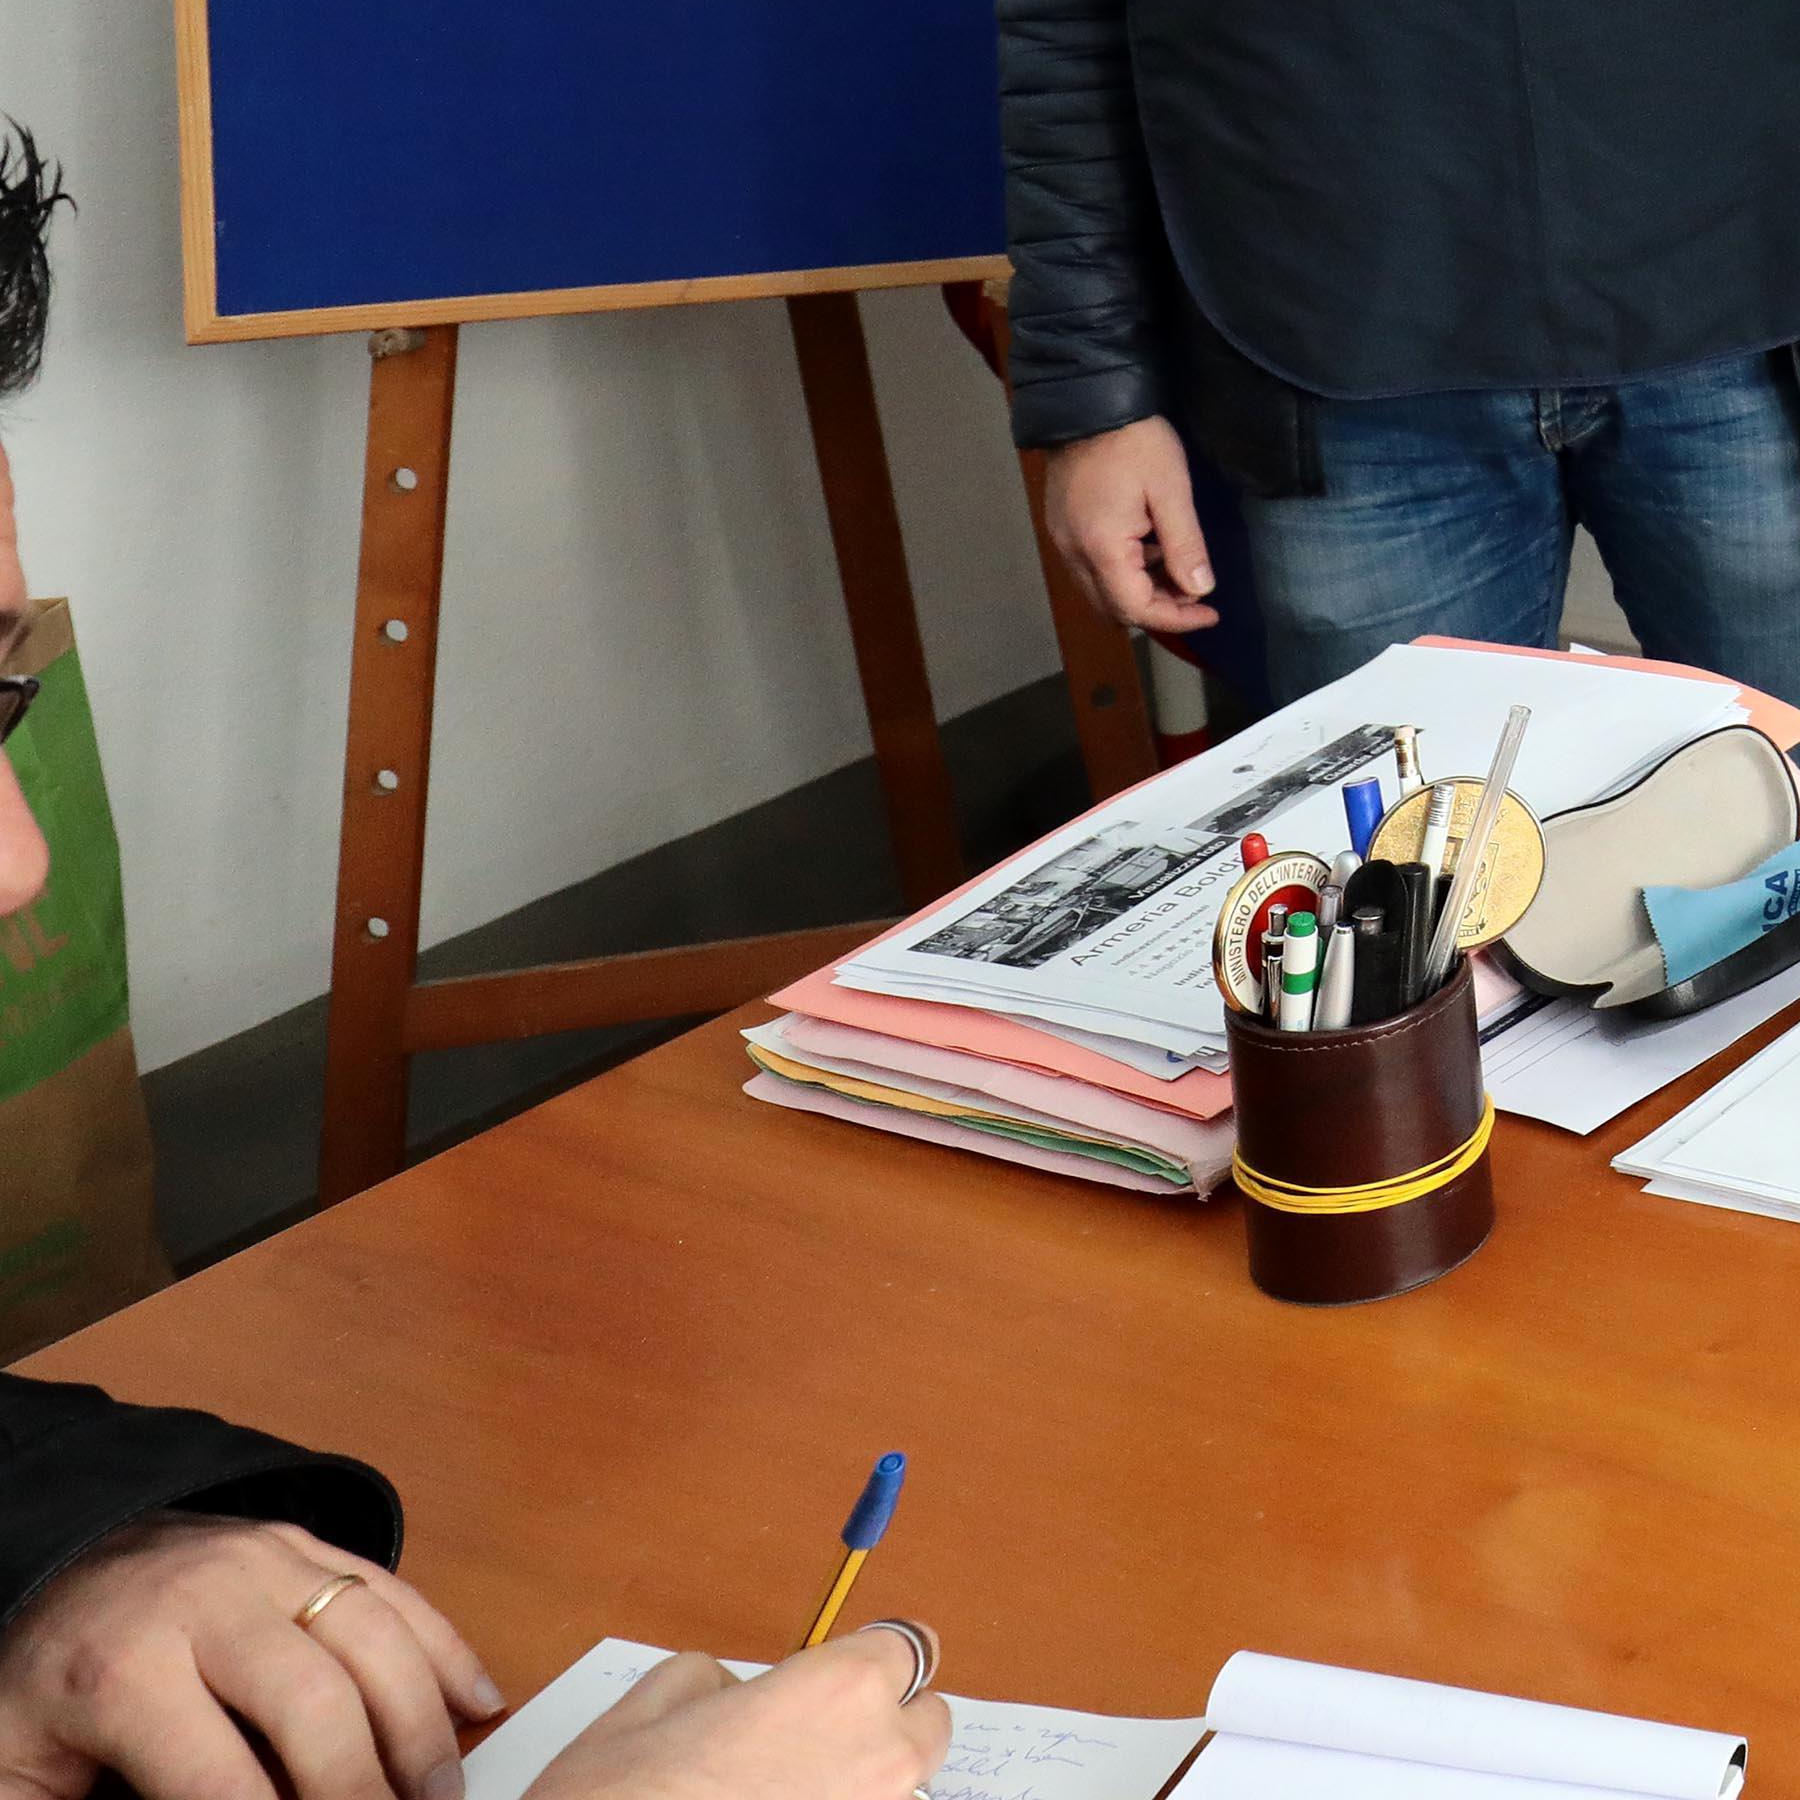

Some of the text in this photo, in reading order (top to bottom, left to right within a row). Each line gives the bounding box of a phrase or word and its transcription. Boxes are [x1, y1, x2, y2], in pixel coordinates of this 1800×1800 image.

[1071, 900, 1179, 967] Armeria
[1228, 863, 1328, 987] MINISTERO DELL'INTERNO
